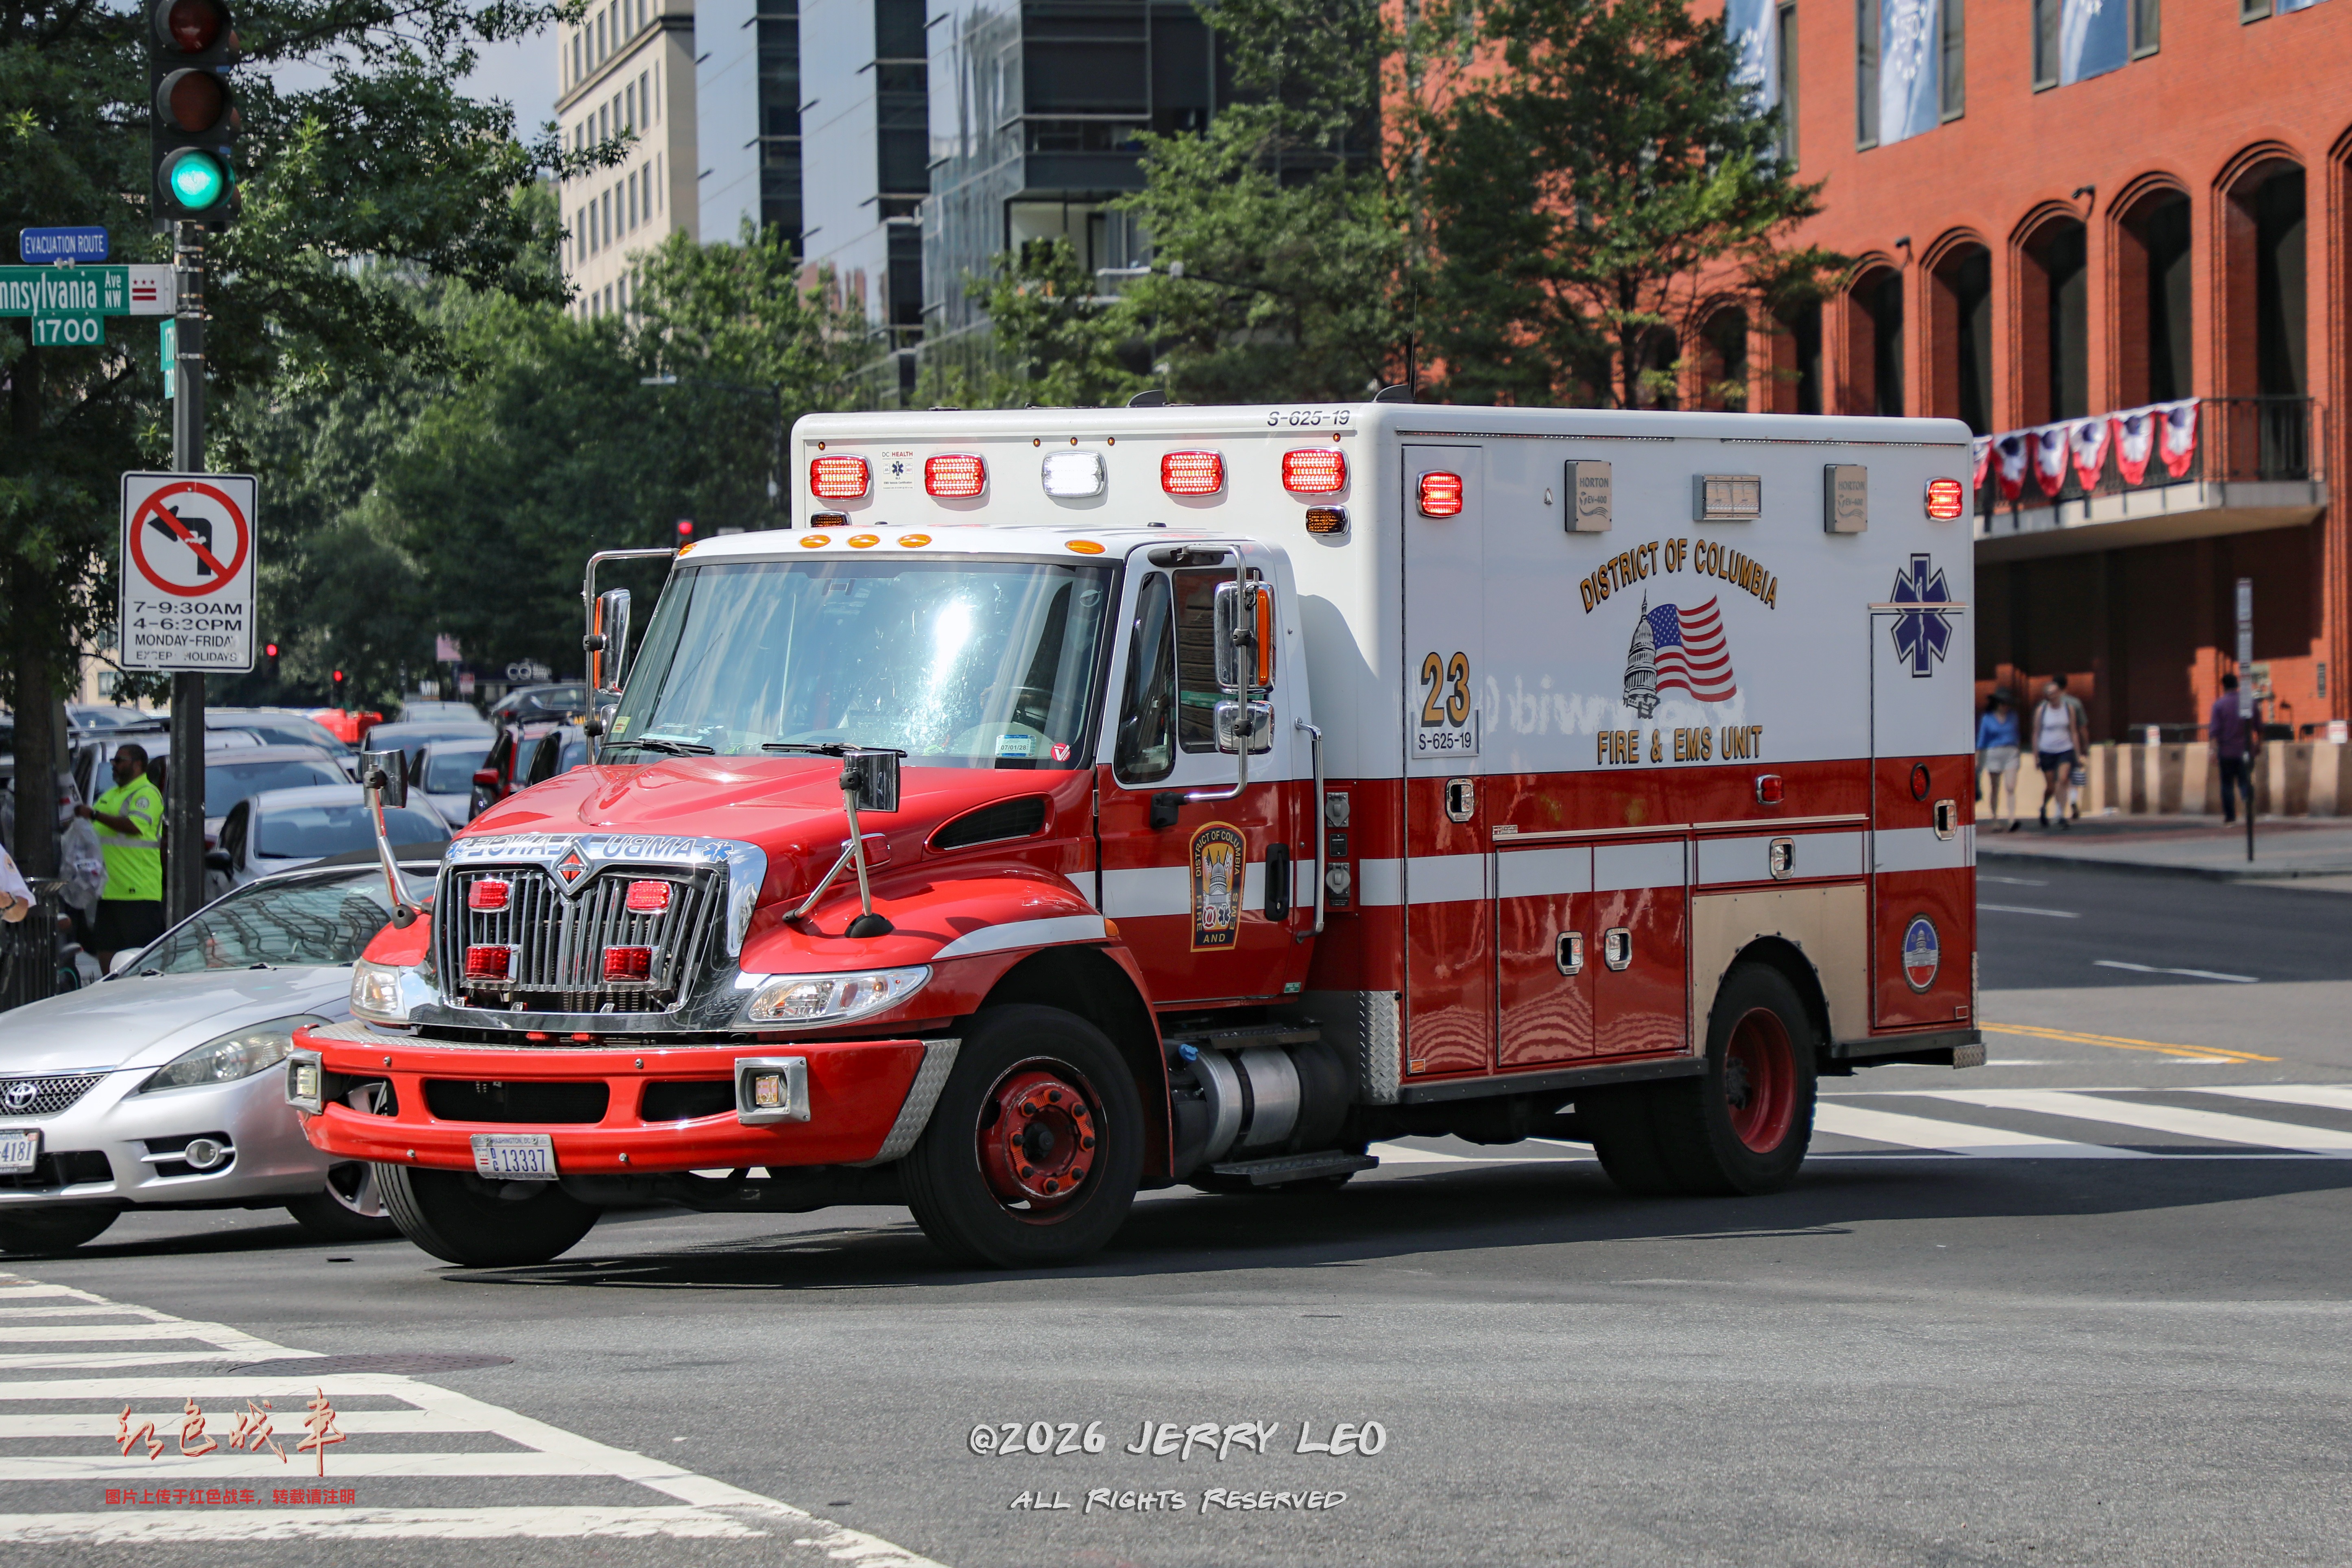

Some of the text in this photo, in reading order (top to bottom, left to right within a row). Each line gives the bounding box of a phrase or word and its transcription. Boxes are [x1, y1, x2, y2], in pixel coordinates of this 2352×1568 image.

[25, 234, 105, 254] EVACUATION ROUTE
[105, 270, 121, 288] Ave
[105, 290, 121, 308] NW
[37, 318, 98, 343] 1700
[1267, 410, 1351, 426] S-625-19
[1580, 477, 1608, 488] HORTON
[1838, 481, 1865, 491] HORTON
[1580, 538, 1778, 614] DISTRICT OF COLUMBIA
[133, 601, 242, 615] 7-9:30AM
[135, 635, 235, 647] MONDAY-FRIDA
[1421, 651, 1471, 728] 23
[1418, 732, 1471, 750] S-625-19
[1597, 725, 1763, 765] FIRE & EMS UNIT
[1195, 831, 1241, 877] DISTRICT OF COLUMBIA
[1229, 892, 1238, 930] EMS
[1203, 933, 1226, 944] AND
[502, 1149, 545, 1172] 13337
